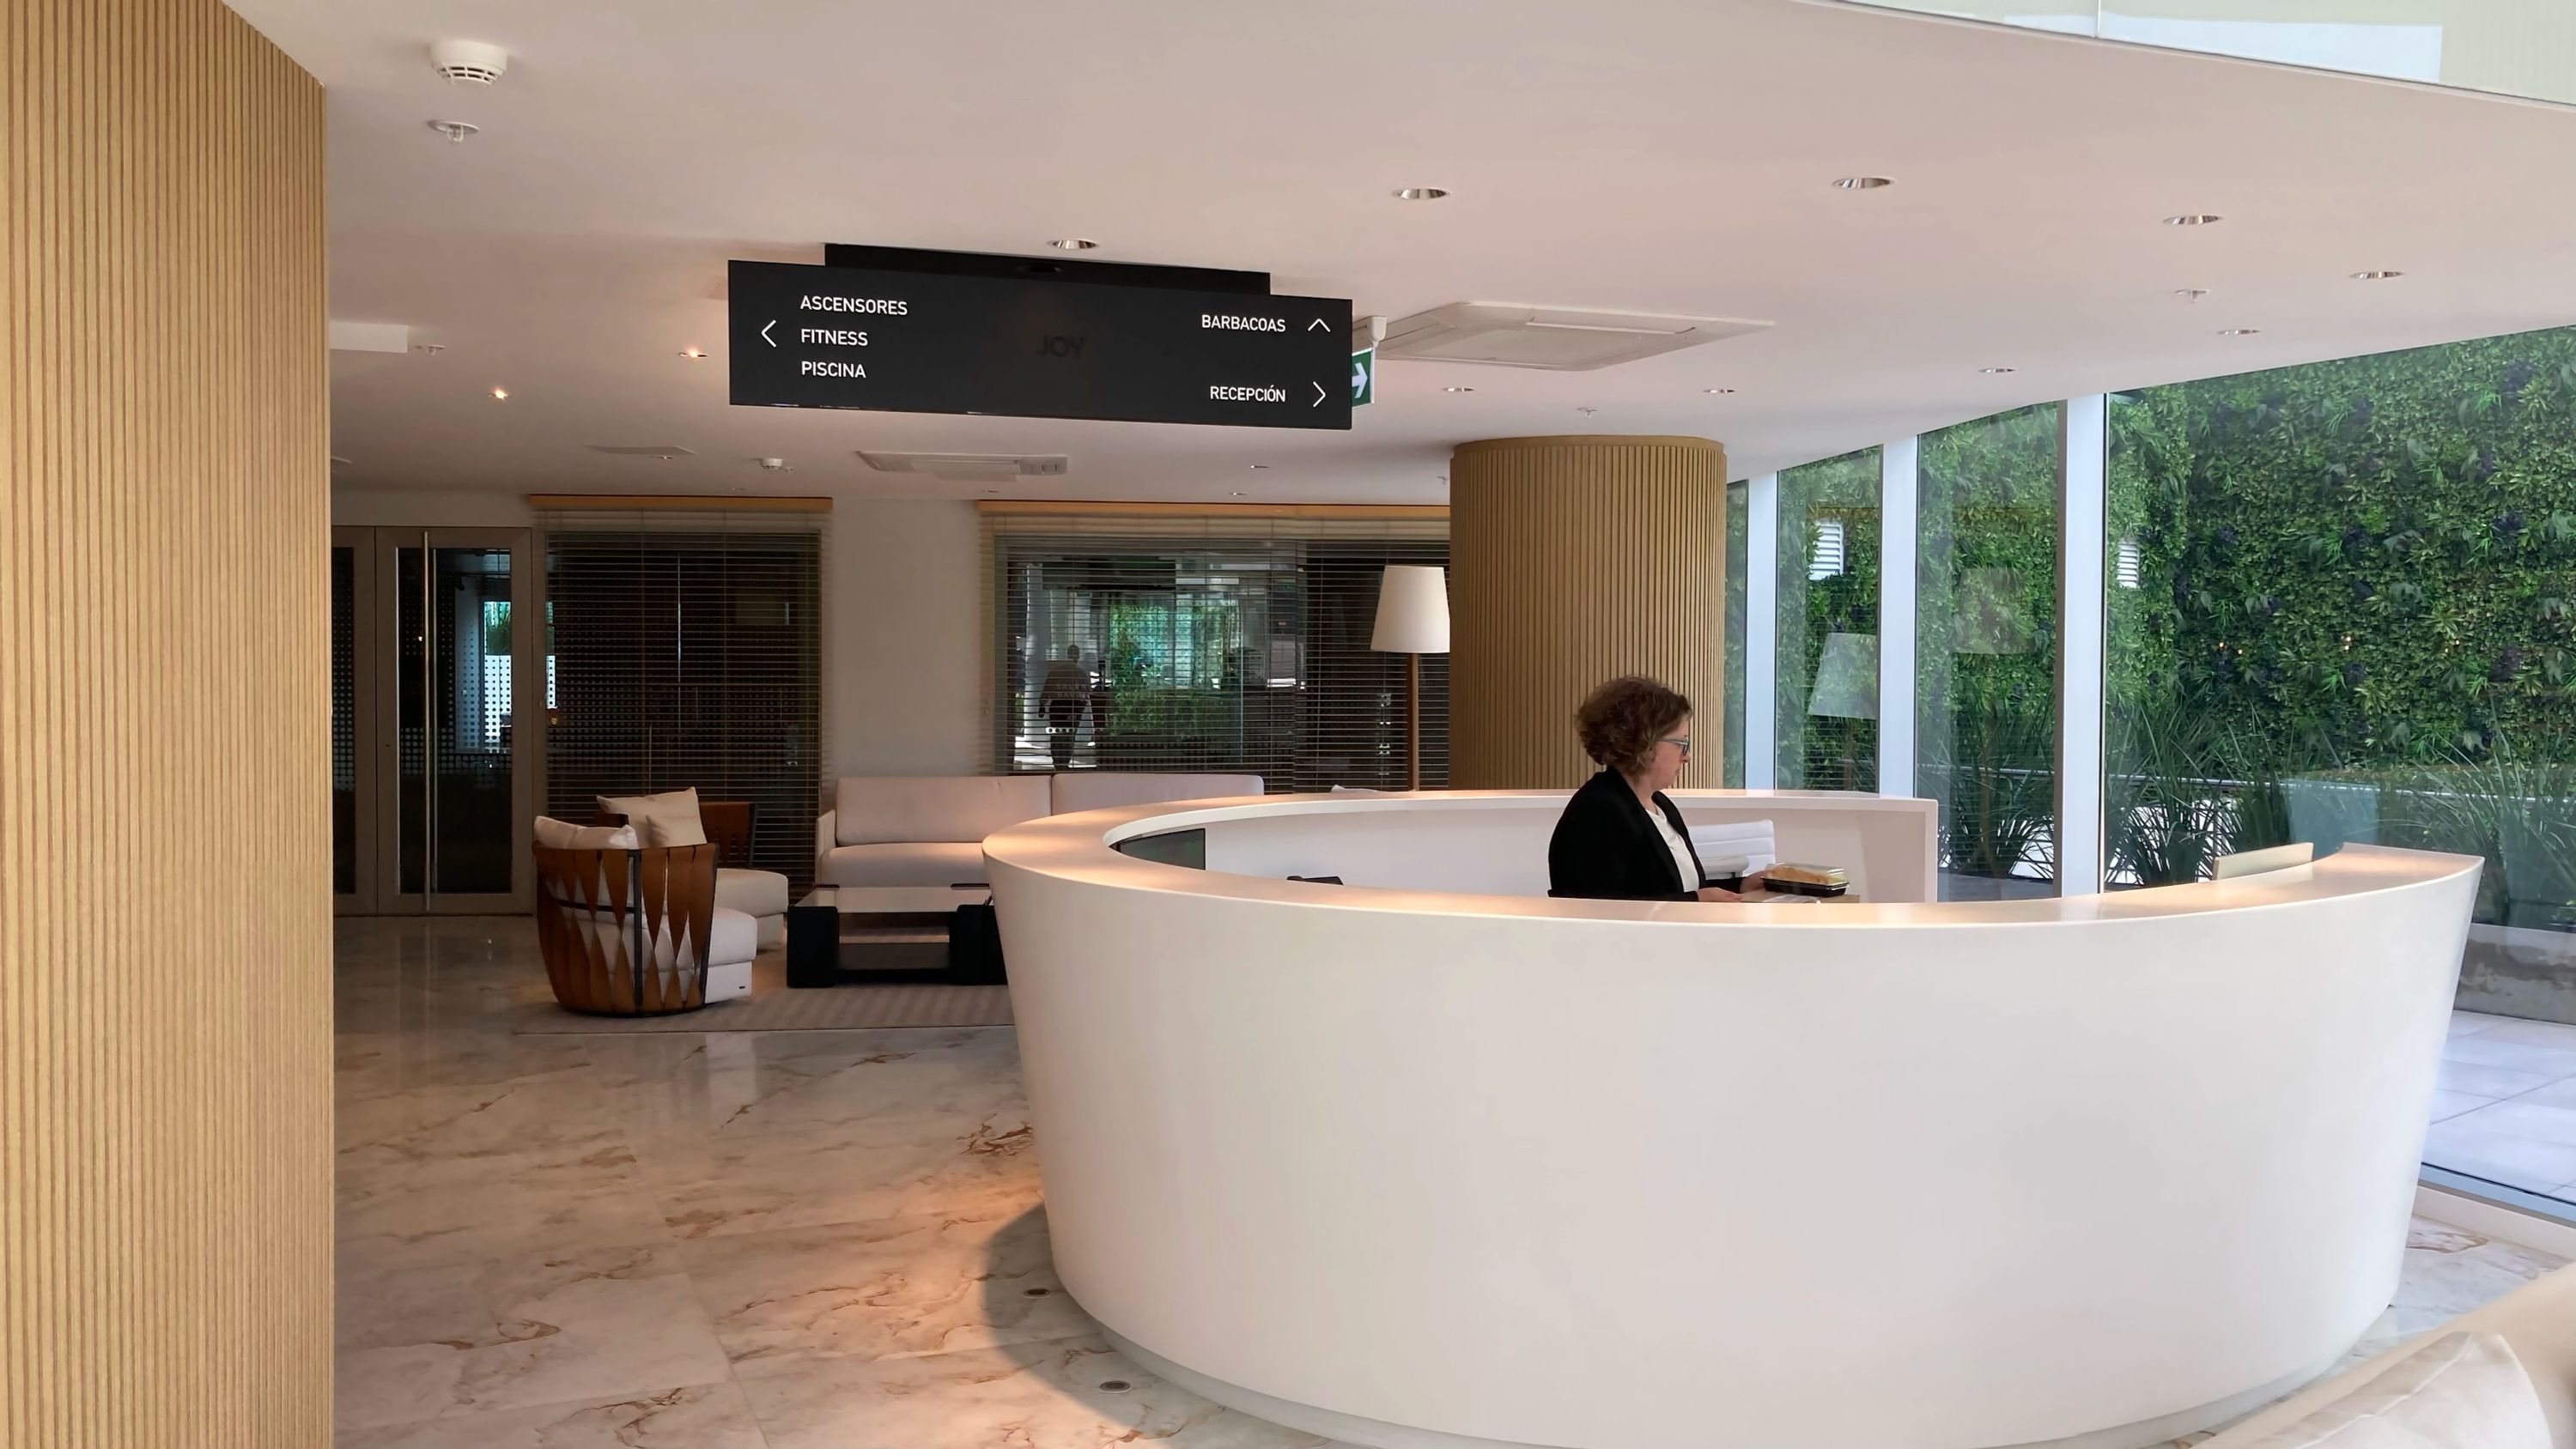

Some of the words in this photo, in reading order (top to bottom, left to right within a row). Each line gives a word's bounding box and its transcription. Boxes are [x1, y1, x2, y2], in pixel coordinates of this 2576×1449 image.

[799, 294, 908, 316] ASCENSORES
[1201, 313, 1286, 333] BARBACOAS
[800, 328, 868, 347] FITNESS
[1037, 334, 1084, 359] JOY
[800, 361, 867, 379] PISCINA
[1210, 384, 1286, 403] RECEPCIÓN
